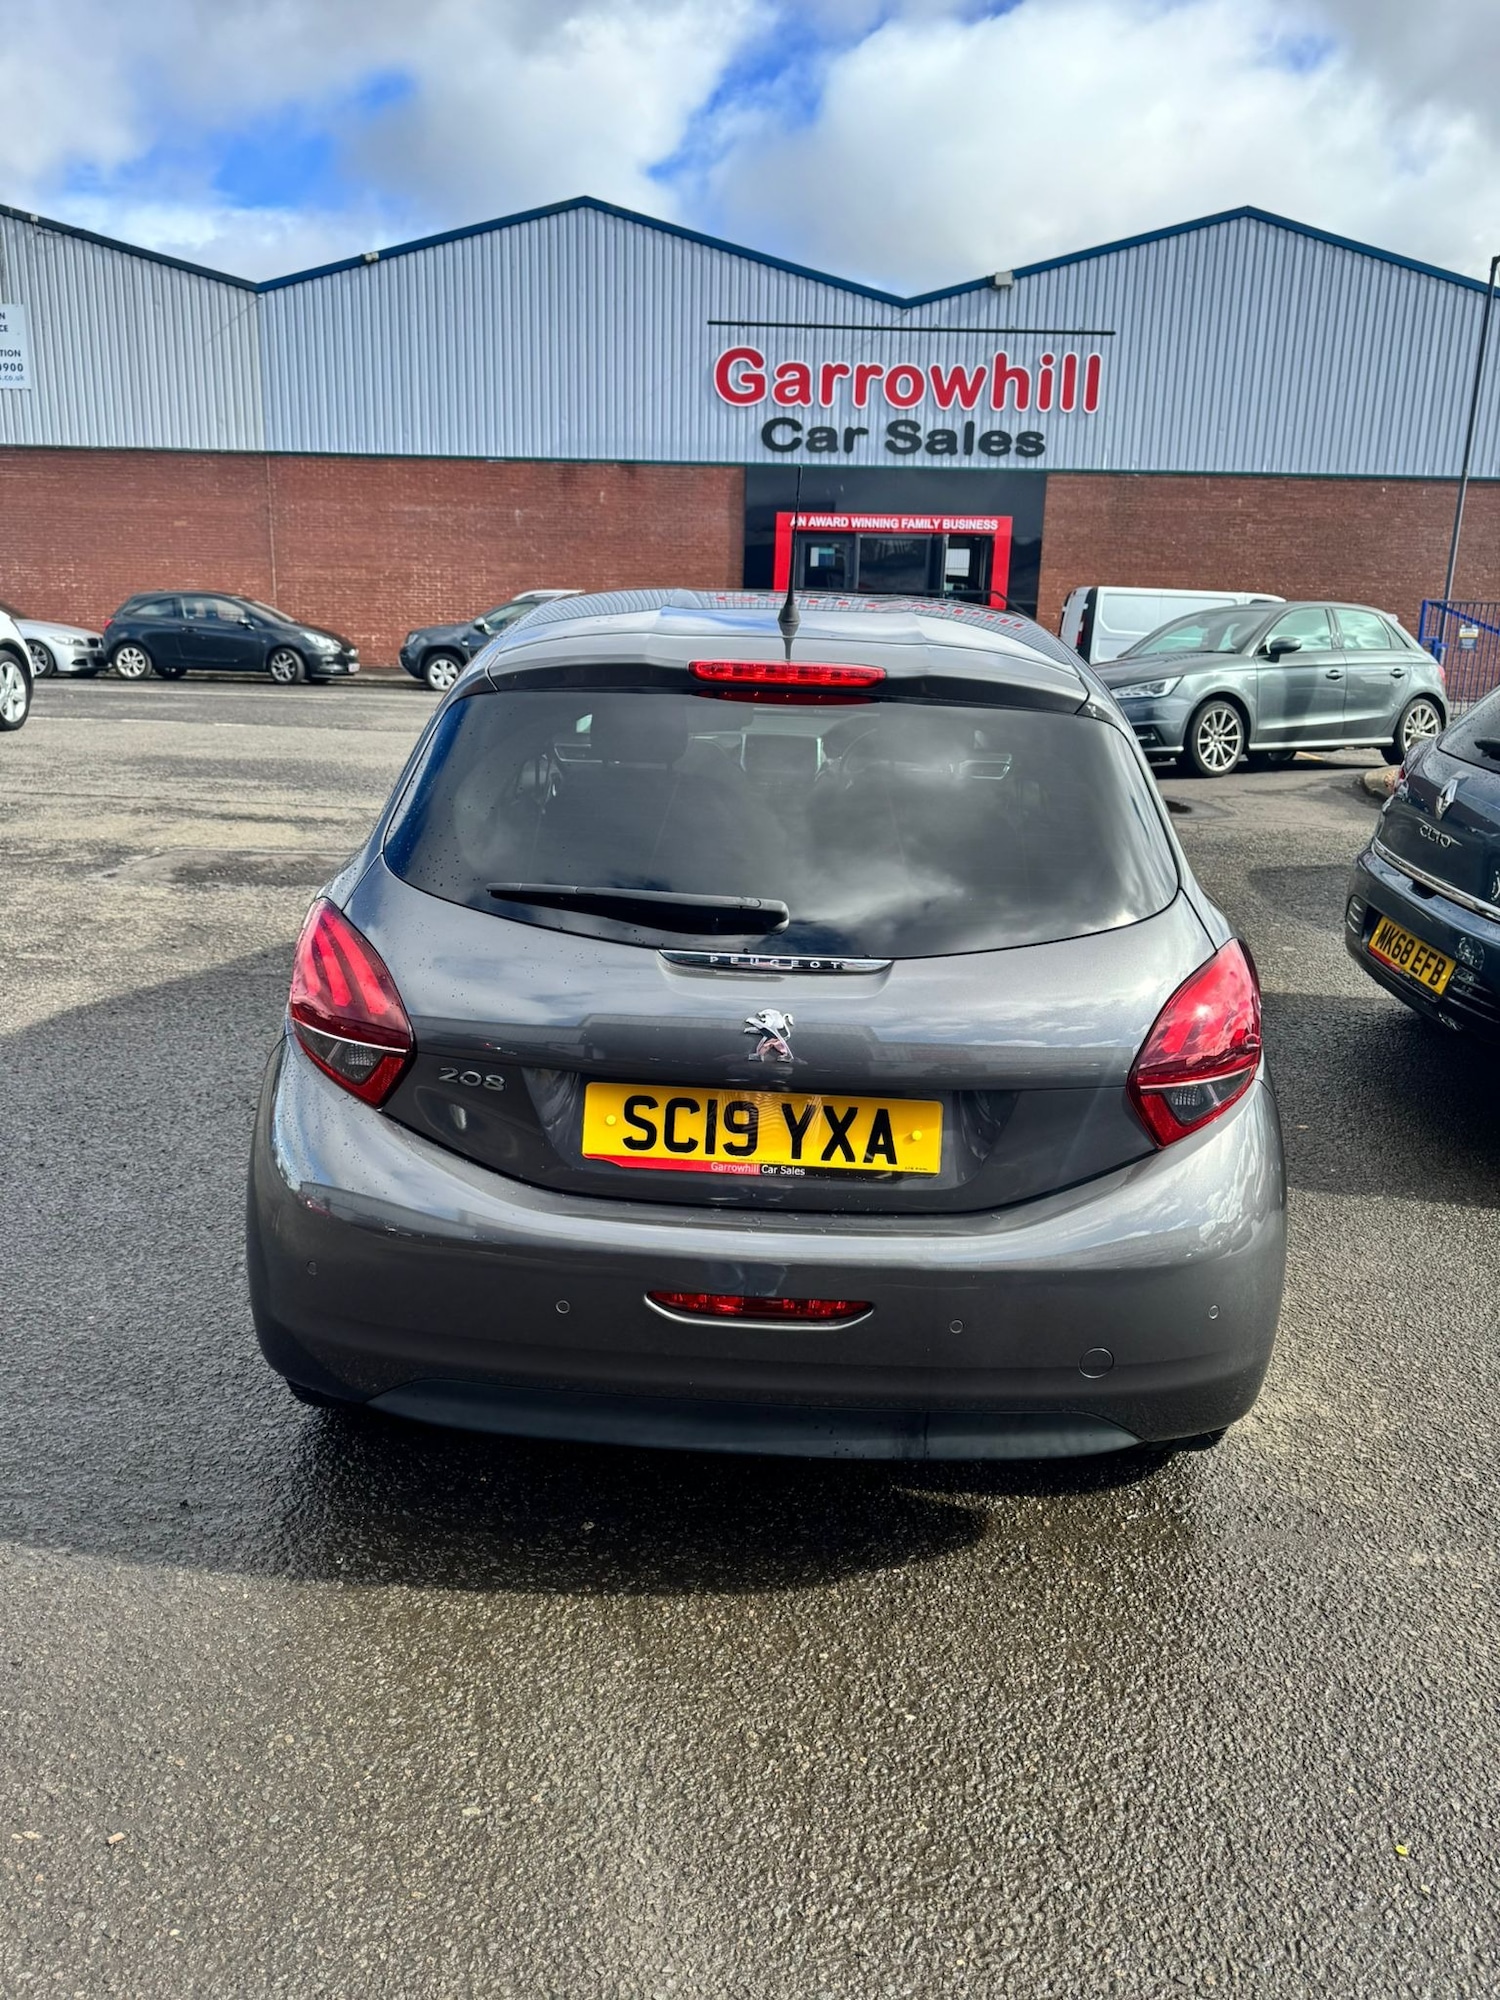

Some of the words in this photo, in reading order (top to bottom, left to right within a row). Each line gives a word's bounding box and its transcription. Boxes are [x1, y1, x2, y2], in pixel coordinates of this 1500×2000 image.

[0, 363, 24, 372] 900
[714, 345, 1101, 414] Garrowhill
[760, 417, 869, 455] Car
[884, 419, 1046, 458] Sales
[808, 516, 849, 528] AWARD
[851, 517, 899, 529] WINNING
[901, 518, 941, 530] FAMILY
[942, 518, 999, 531] BUSINESS
[1419, 824, 1452, 848] CLIO
[709, 956, 842, 969] PEUGEOT
[1375, 921, 1415, 965] MK68
[1410, 944, 1448, 986] EFB
[438, 1067, 506, 1091] 208
[622, 1095, 760, 1157] SC19
[781, 1102, 898, 1165] YXA
[711, 1161, 761, 1175] Garrowhill
[761, 1165, 779, 1175] Car
[780, 1165, 806, 1176] Sales
